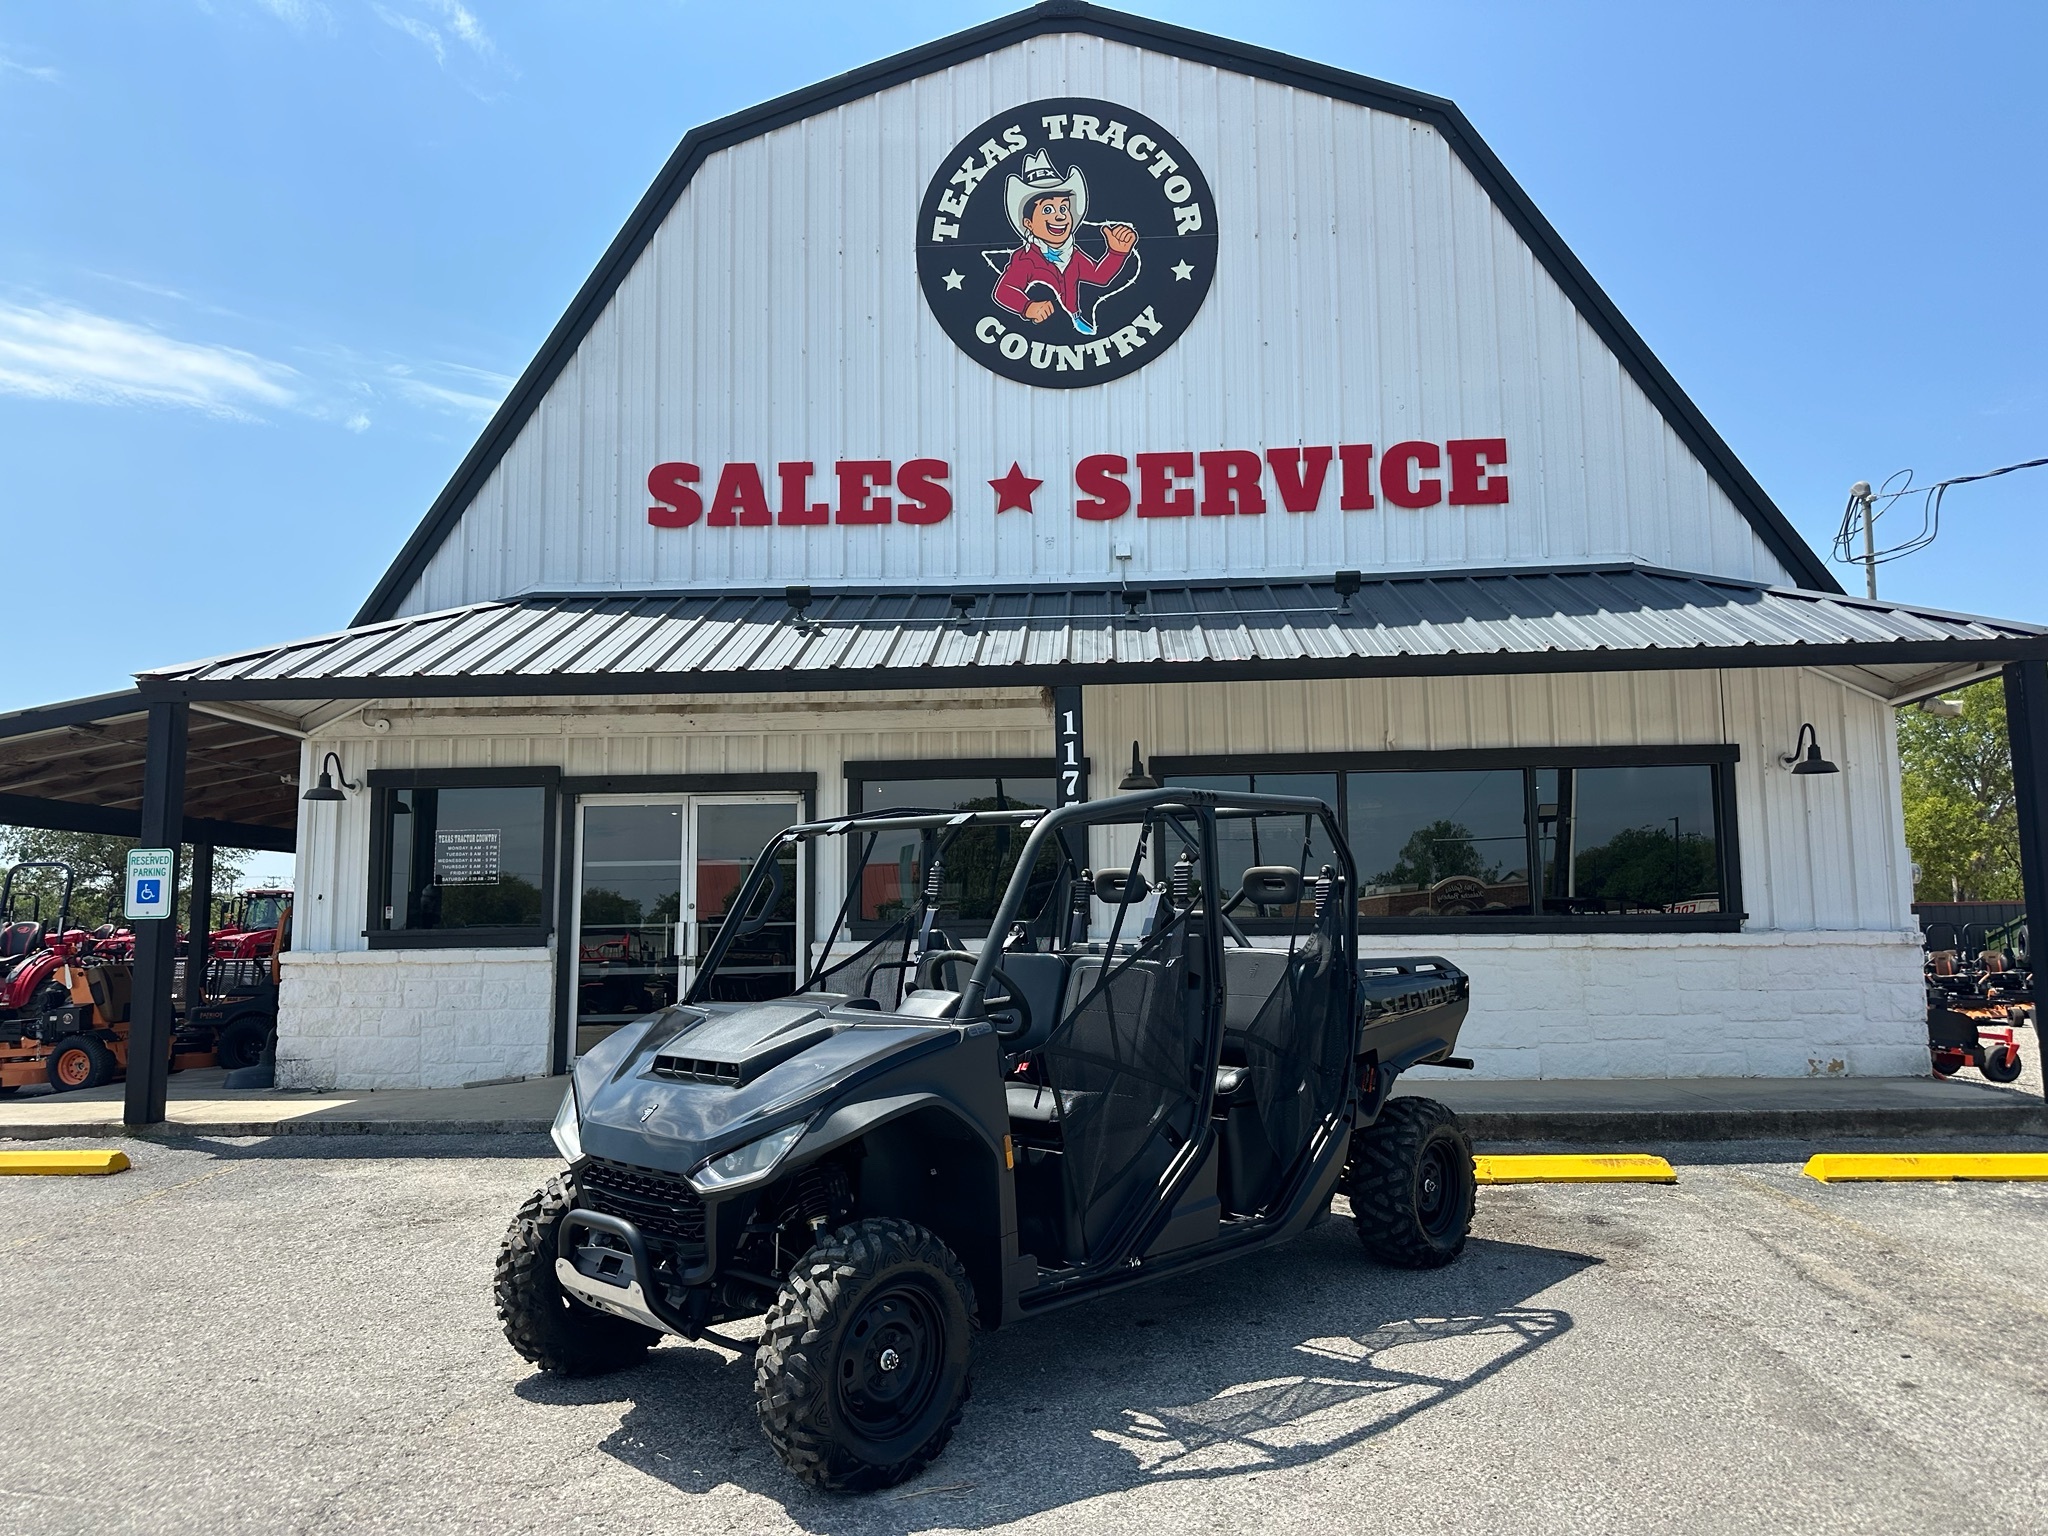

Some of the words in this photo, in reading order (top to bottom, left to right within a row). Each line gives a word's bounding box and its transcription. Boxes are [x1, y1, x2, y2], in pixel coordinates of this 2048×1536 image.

[932, 125, 1028, 242] TEXAS
[1042, 114, 1202, 236] TRACTOR
[1027, 170, 1056, 181] TEX
[975, 305, 1163, 371] COUNTRY
[647, 458, 953, 529] SALES
[1075, 438, 1509, 521] SERVICE
[1062, 710, 1080, 808] 117
[438, 834, 454, 843] TEXAS
[454, 834, 476, 843] TRACTOR
[476, 833, 498, 843] COUNTRY
[130, 855, 170, 865] RESERVED
[133, 867, 167, 877] PARKING
[1381, 984, 1457, 1014] SEGWAY
